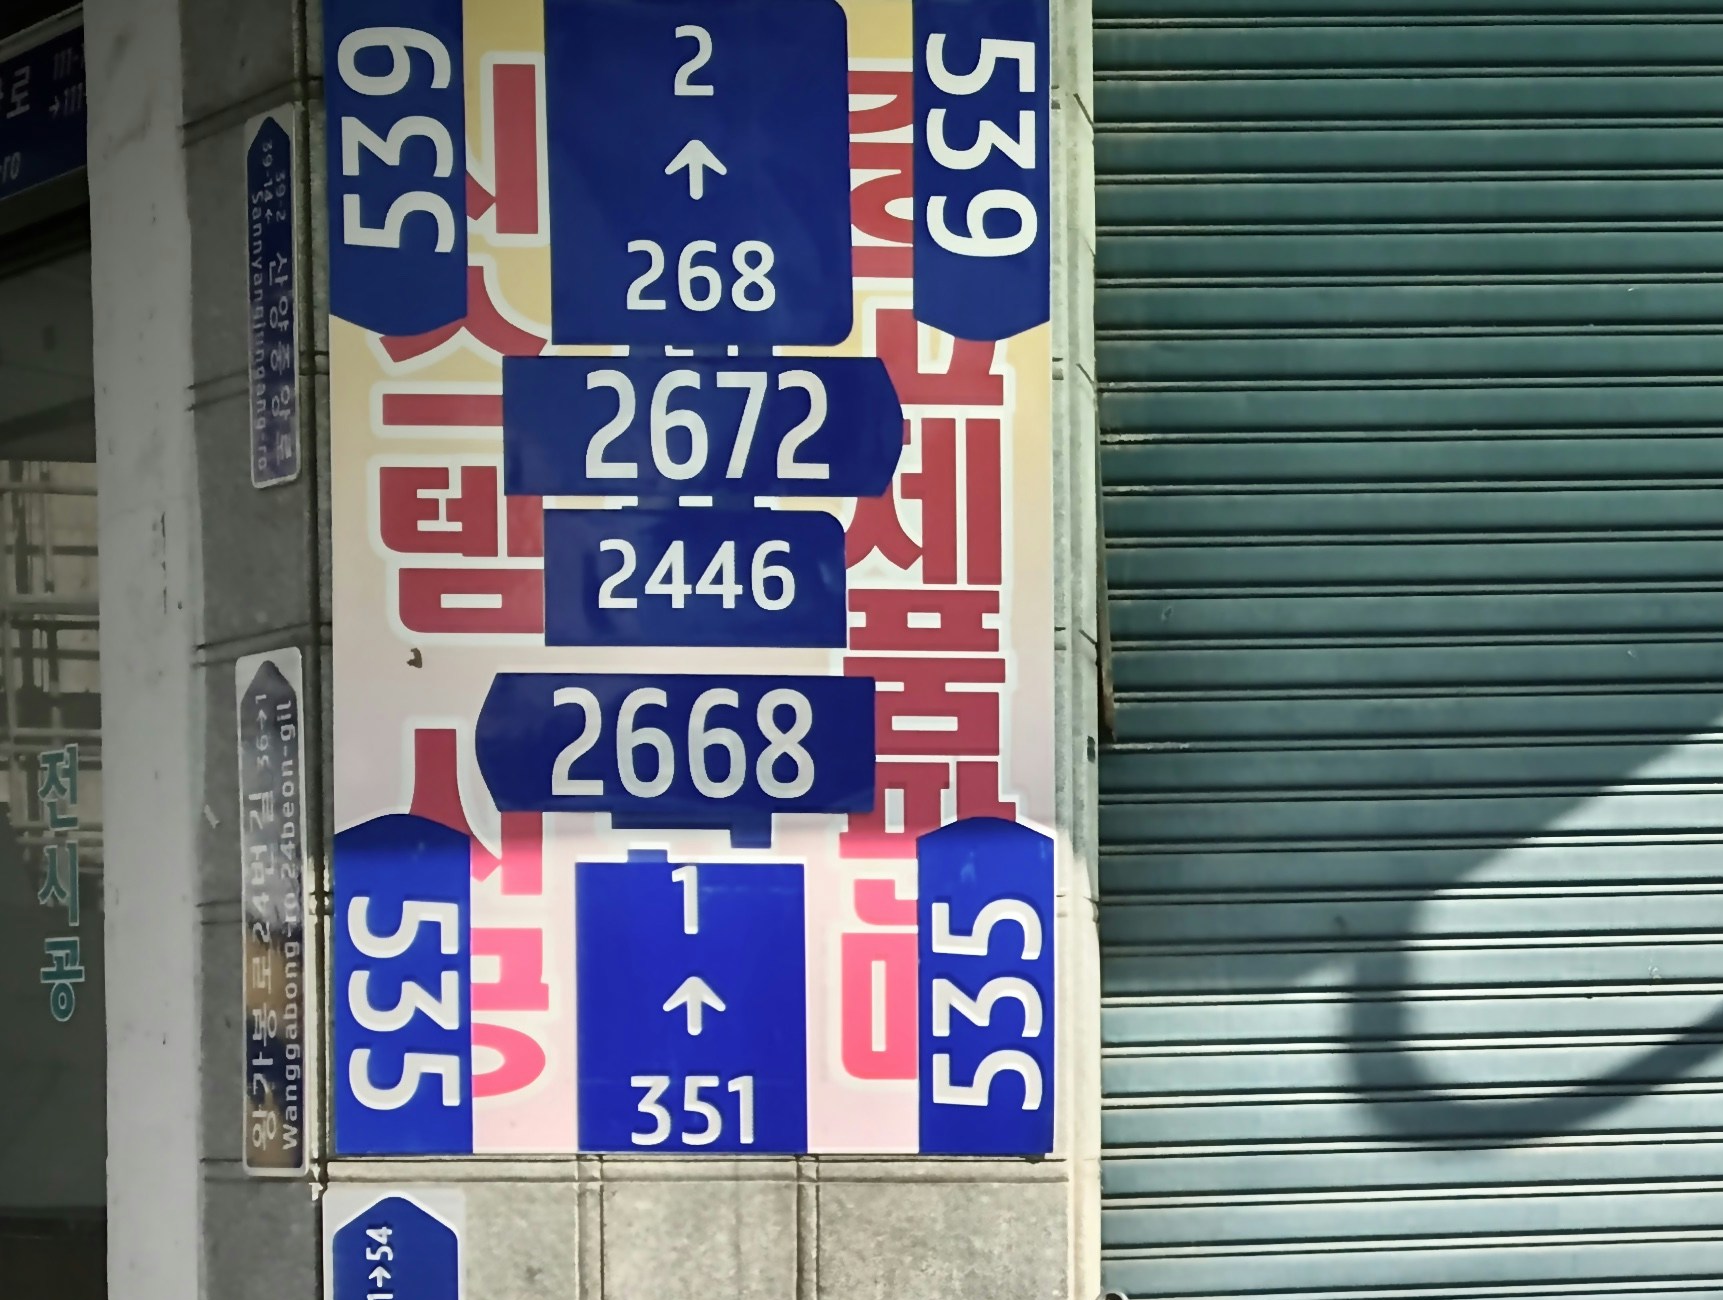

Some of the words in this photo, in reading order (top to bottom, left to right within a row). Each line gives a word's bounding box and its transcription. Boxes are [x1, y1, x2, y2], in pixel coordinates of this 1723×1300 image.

[337, 27, 455, 253] 539
[674, 25, 714, 96] 2
[925, 33, 1038, 258] 539
[268, 252, 292, 465] 산양중앙로
[626, 240, 776, 311] 268
[586, 370, 830, 480] 2672
[598, 539, 795, 610] 2446
[276, 700, 297, 880] 24beon-gil
[552, 687, 815, 799] 2668
[249, 790, 278, 1151] 왕가봉로24번길
[671, 866, 699, 936] 1
[281, 892, 301, 1150] Wanggabong-ro
[347, 897, 461, 1111] 535
[932, 899, 1043, 1110] 535
[630, 1076, 754, 1146] 351
